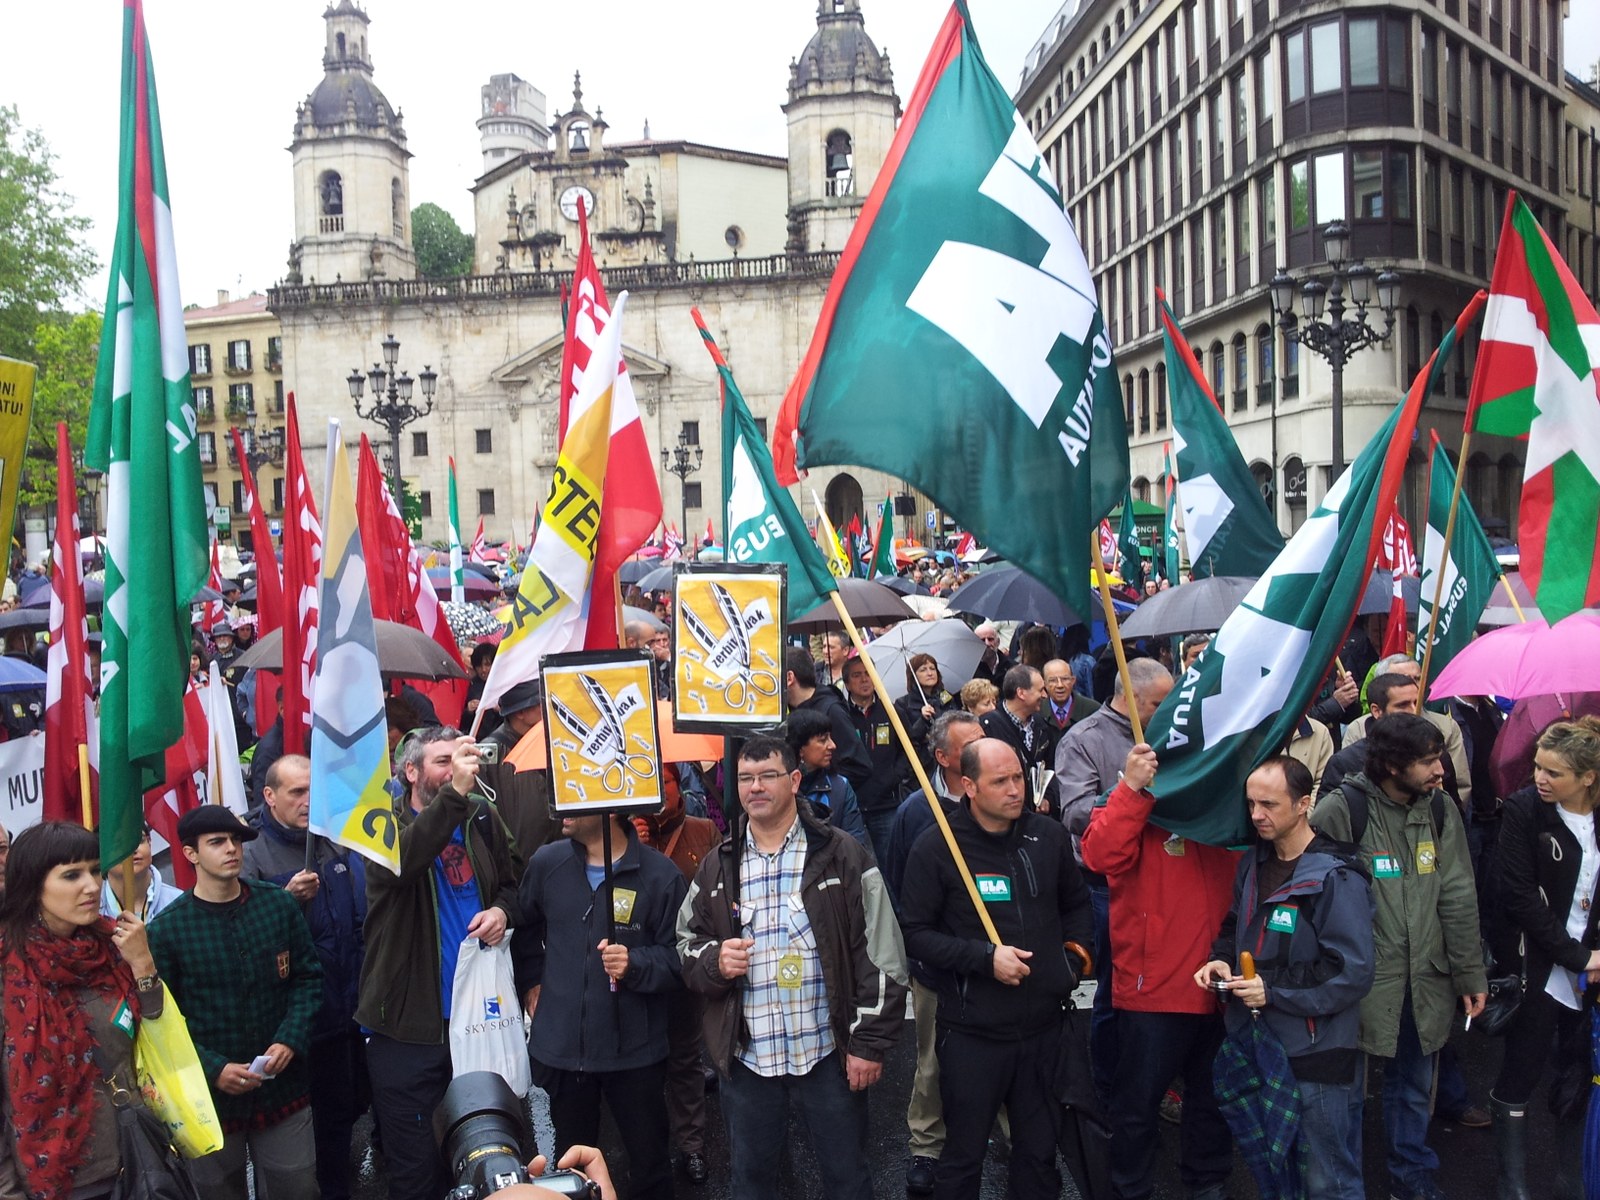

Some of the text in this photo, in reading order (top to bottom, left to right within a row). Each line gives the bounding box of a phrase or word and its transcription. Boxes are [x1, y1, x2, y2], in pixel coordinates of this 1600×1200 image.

[927, 514, 935, 527] P
[1166, 650, 1205, 751] ATUA
[1272, 909, 1292, 924] LA
[465, 1023, 487, 1035] SKY
